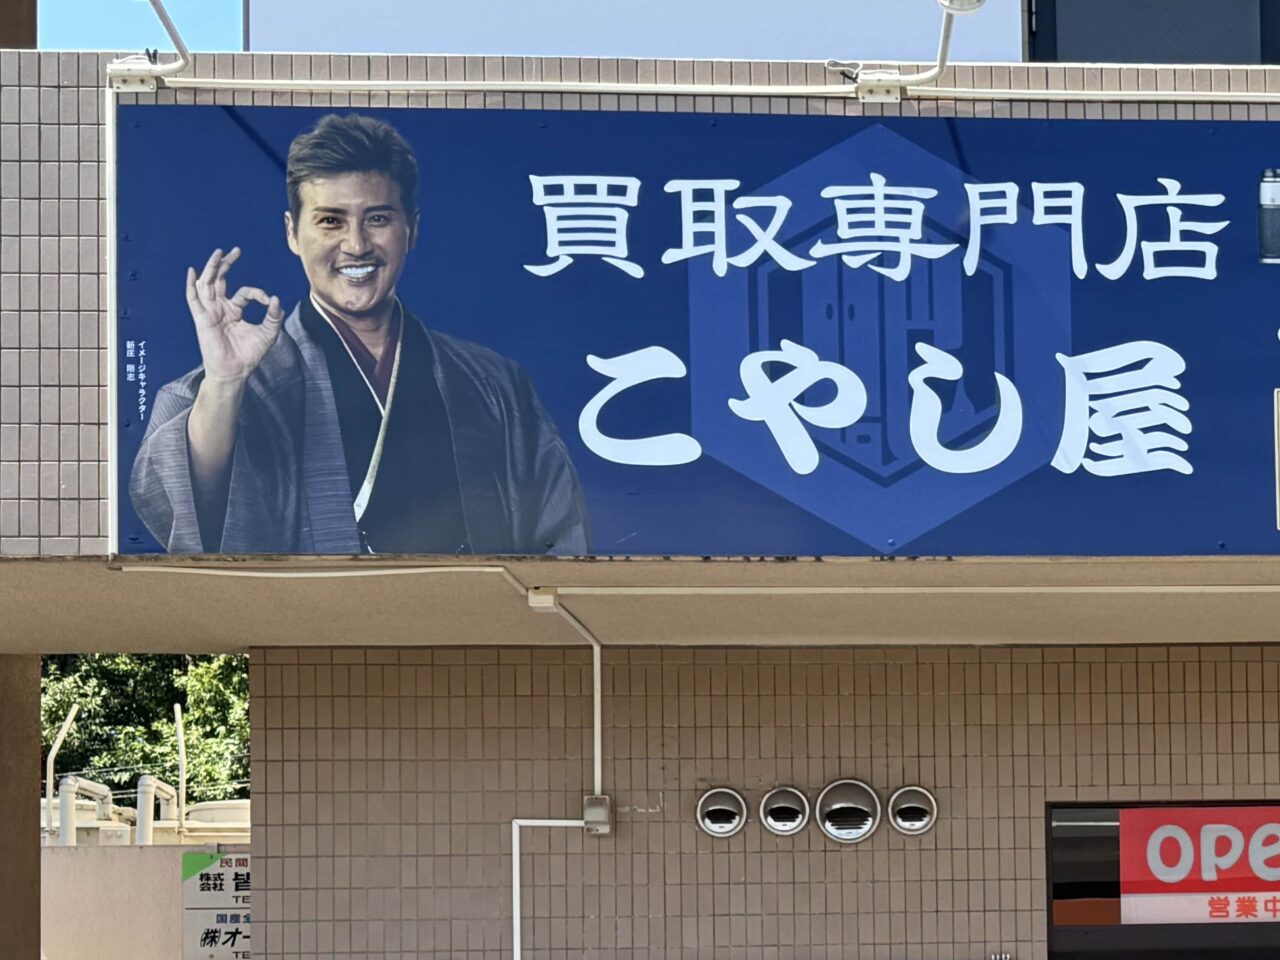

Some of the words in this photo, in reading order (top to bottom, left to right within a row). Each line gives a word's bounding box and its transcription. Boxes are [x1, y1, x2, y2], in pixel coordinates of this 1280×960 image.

[522, 172, 1231, 282] 買取専門店
[138, 340, 147, 420] イメージキャラクター
[578, 339, 1194, 477] こやし屋
